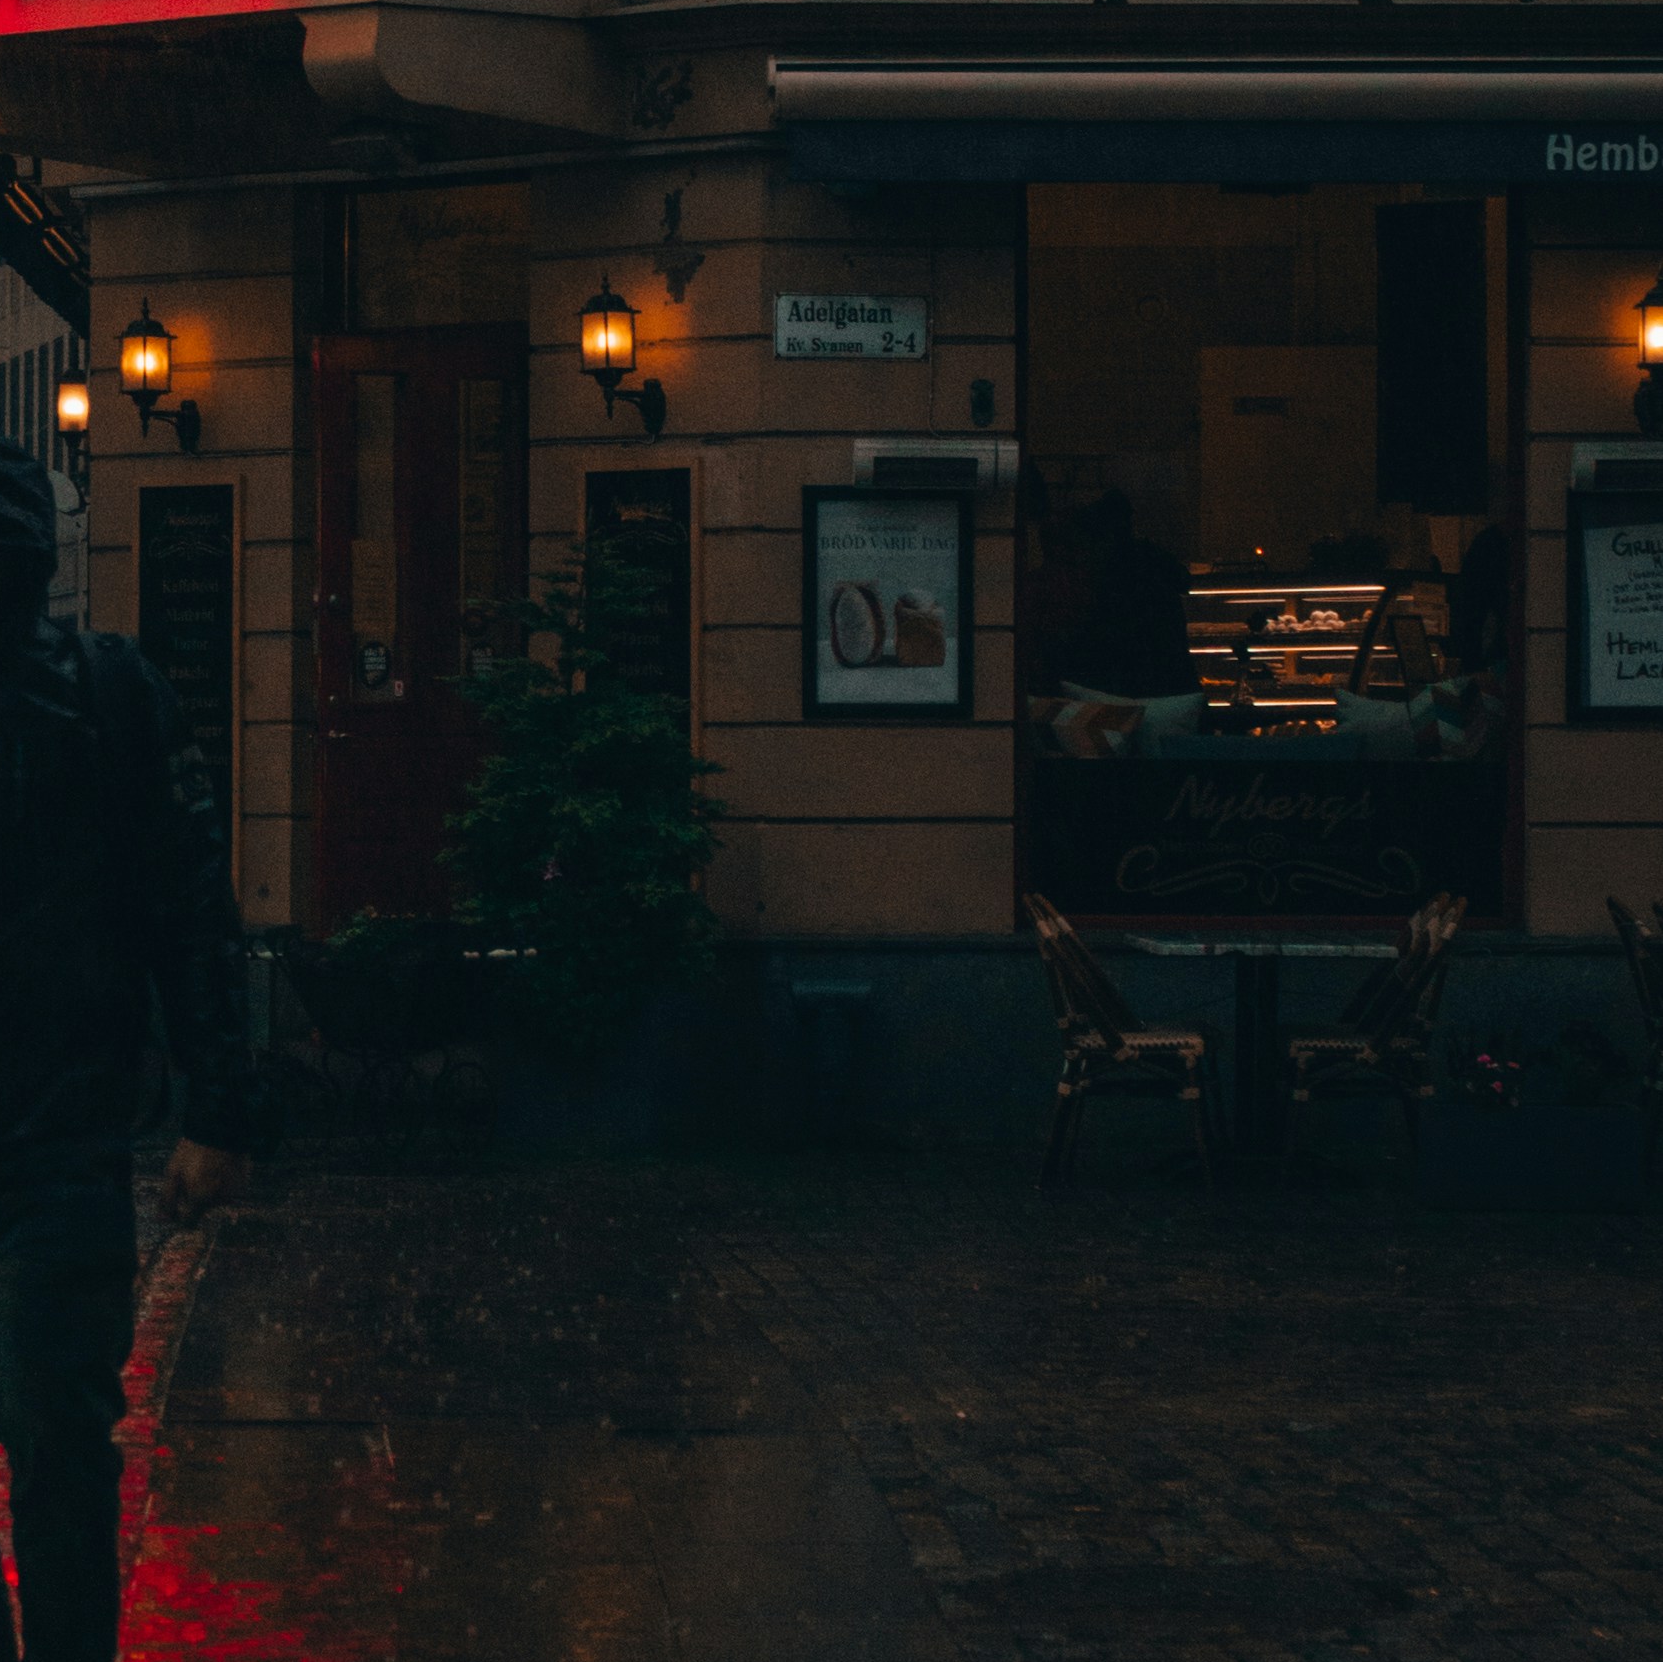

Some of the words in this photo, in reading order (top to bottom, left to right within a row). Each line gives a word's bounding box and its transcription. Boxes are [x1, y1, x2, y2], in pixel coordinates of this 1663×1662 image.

[1546, 134, 1663, 172] Hemb
[788, 301, 893, 328] Adelgatan
[787, 338, 806, 352] Kv.
[812, 338, 863, 353] Svanen
[882, 332, 916, 353] 2-4
[821, 534, 866, 550] BRÖD
[1617, 661, 1663, 680] LAS
[1163, 772, 1376, 839] Nybergs
